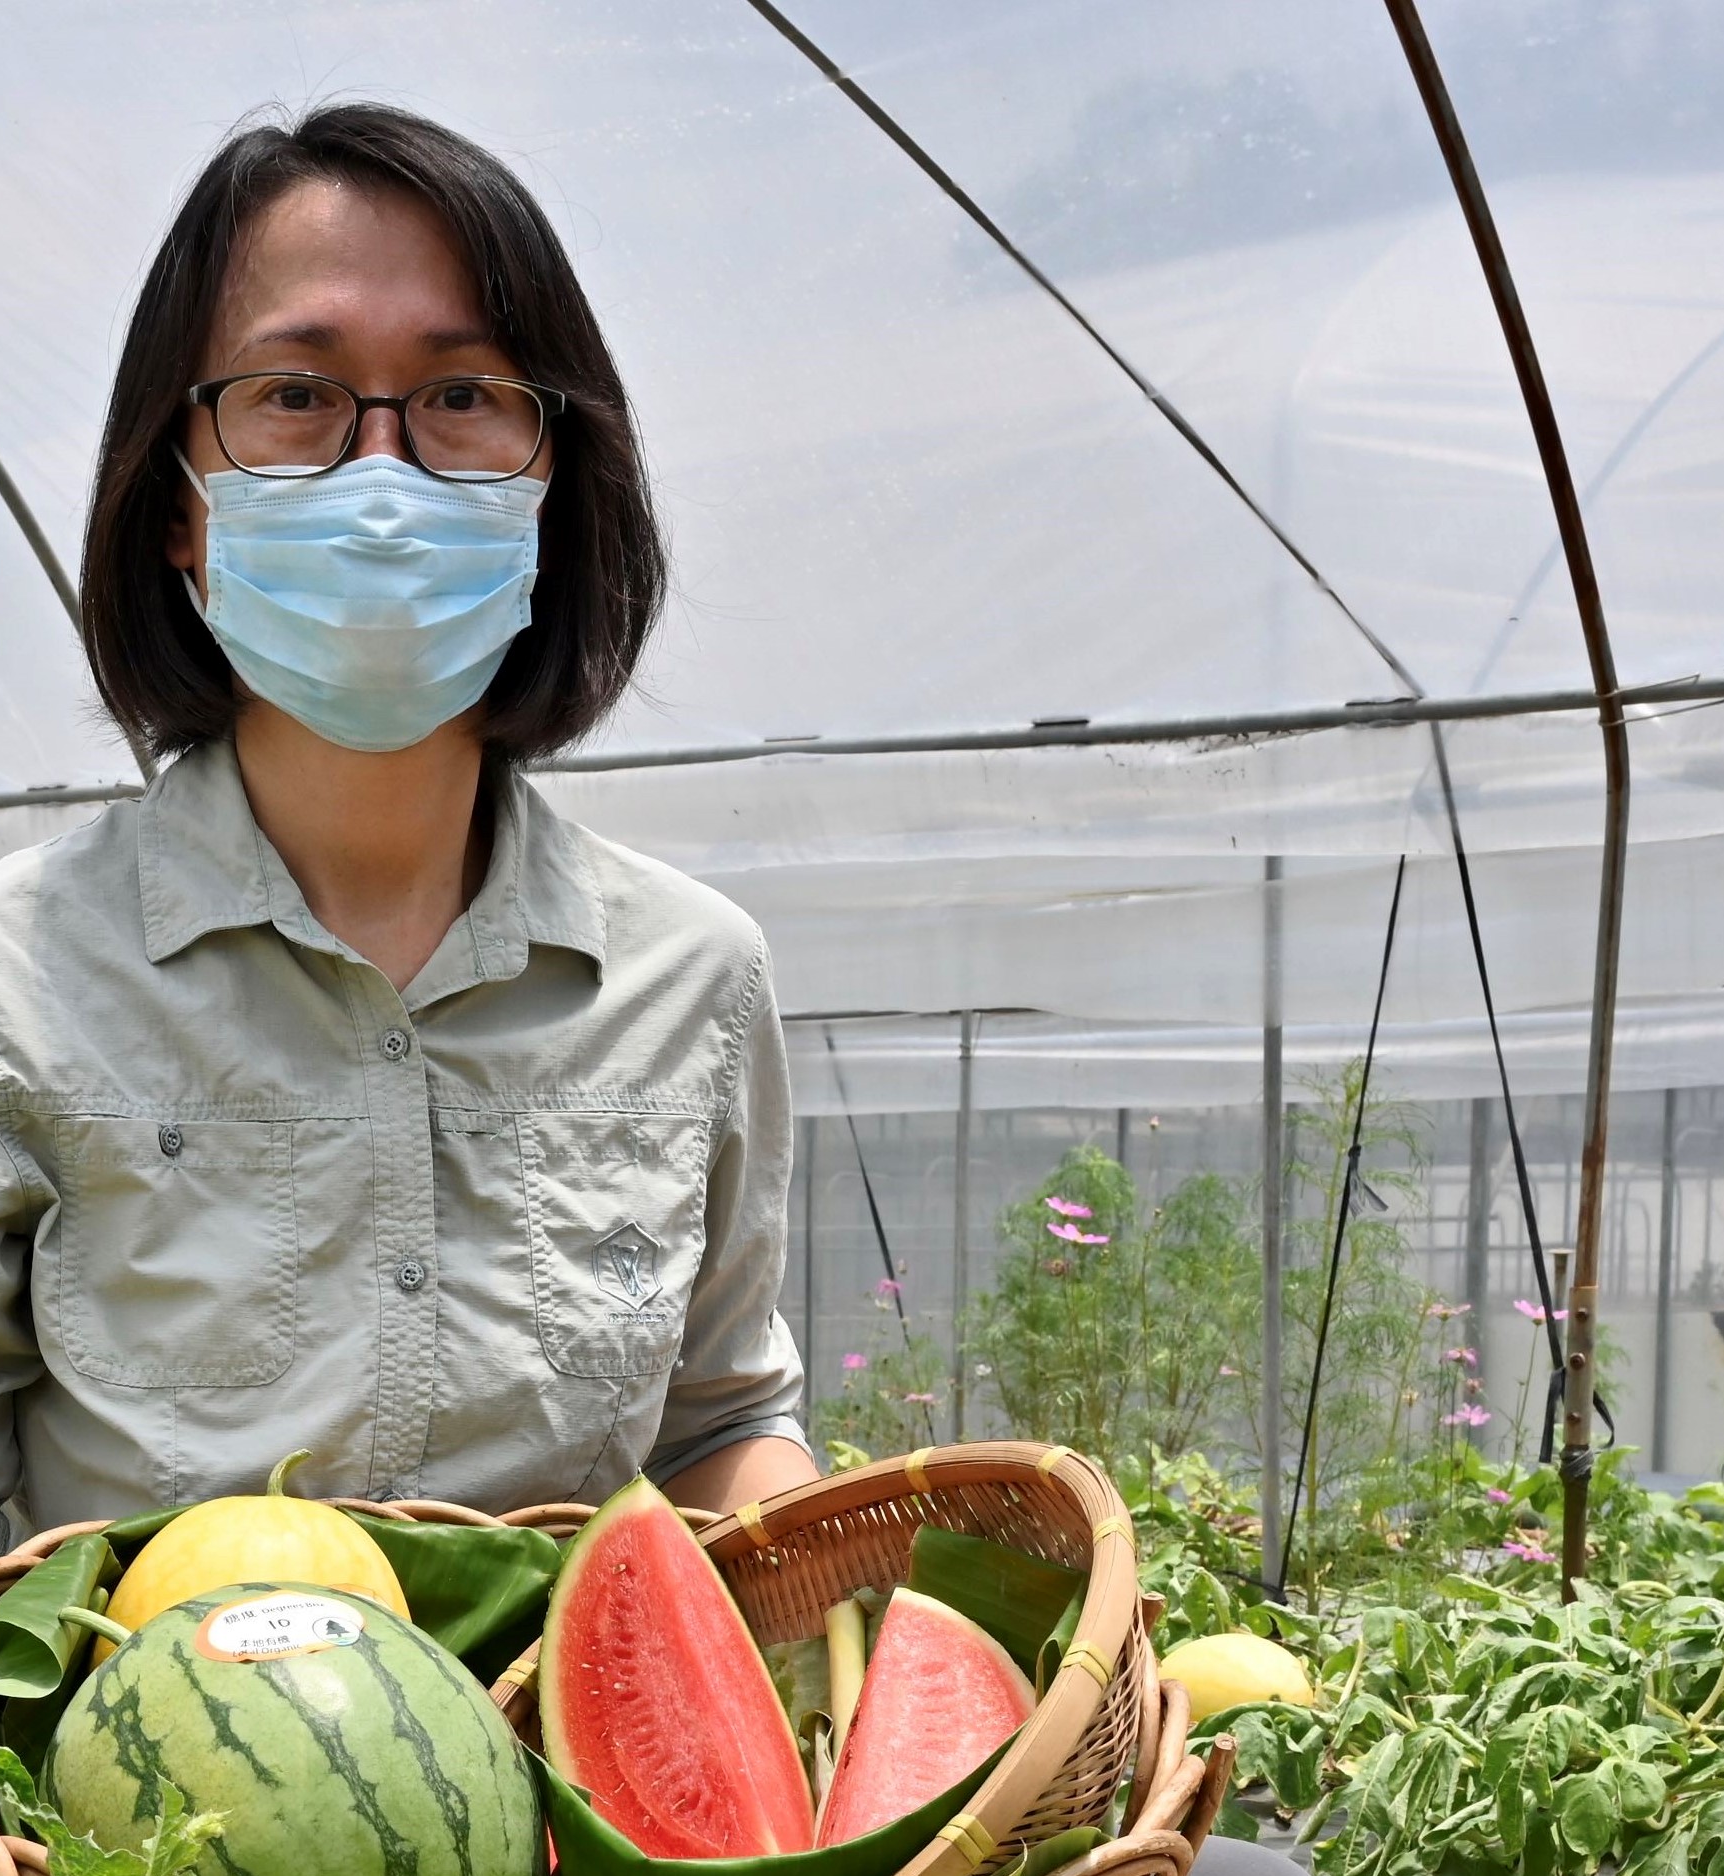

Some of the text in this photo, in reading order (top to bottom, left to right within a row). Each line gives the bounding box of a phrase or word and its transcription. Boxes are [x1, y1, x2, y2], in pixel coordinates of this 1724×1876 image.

[268, 1619, 291, 1630] 10
[240, 1635, 291, 1648] 本地有機
[232, 1644, 301, 1658] Local Organic
